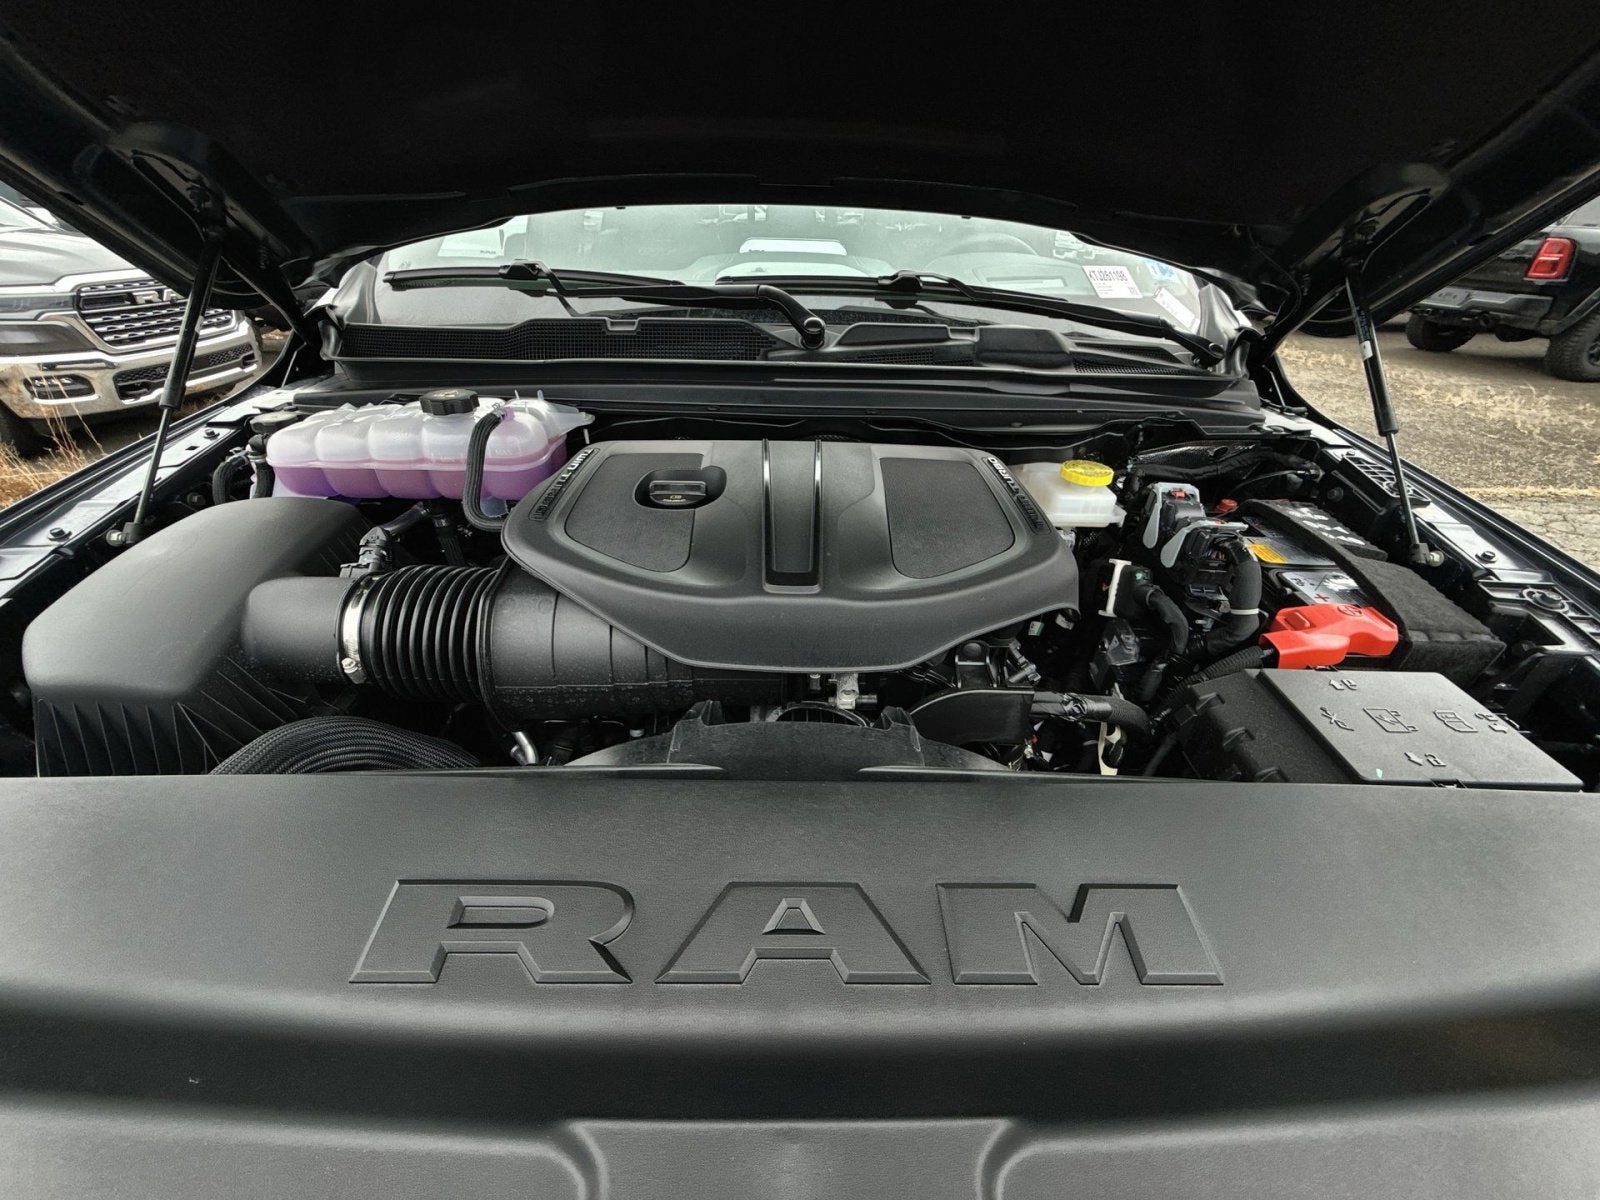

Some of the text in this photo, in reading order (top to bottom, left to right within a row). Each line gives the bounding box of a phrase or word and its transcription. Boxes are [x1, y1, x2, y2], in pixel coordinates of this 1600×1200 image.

[132, 288, 186, 305] RA
[987, 456, 1021, 495] TURBO
[348, 879, 1223, 986] RAM
